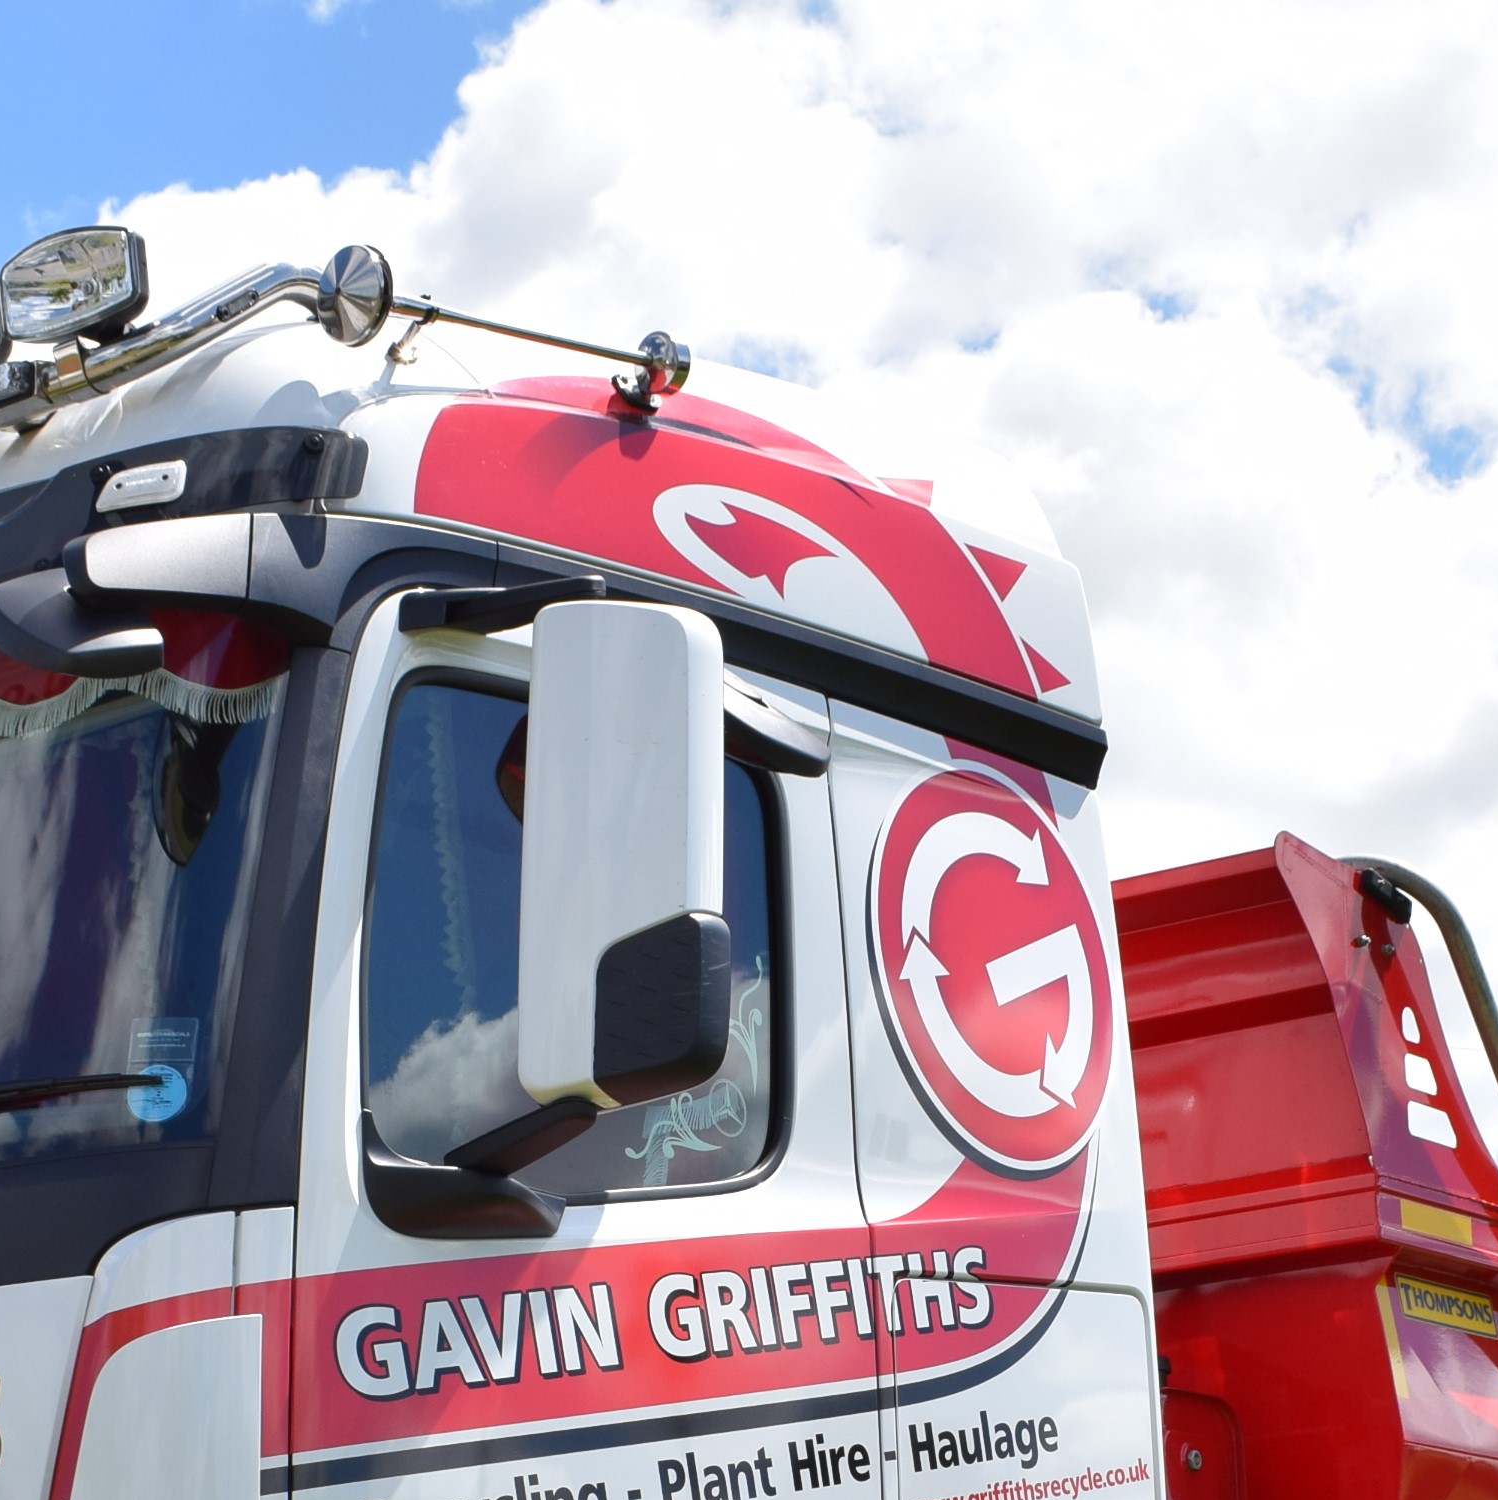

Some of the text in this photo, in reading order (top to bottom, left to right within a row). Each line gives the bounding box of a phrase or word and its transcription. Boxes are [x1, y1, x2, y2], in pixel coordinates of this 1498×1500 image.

[335, 1246, 994, 1401] GAVIN GRIFFITHS
[1401, 1283, 1493, 1325] THOMPSONS
[788, 1433, 871, 1492] Hire
[908, 1410, 1059, 1473] Haulage
